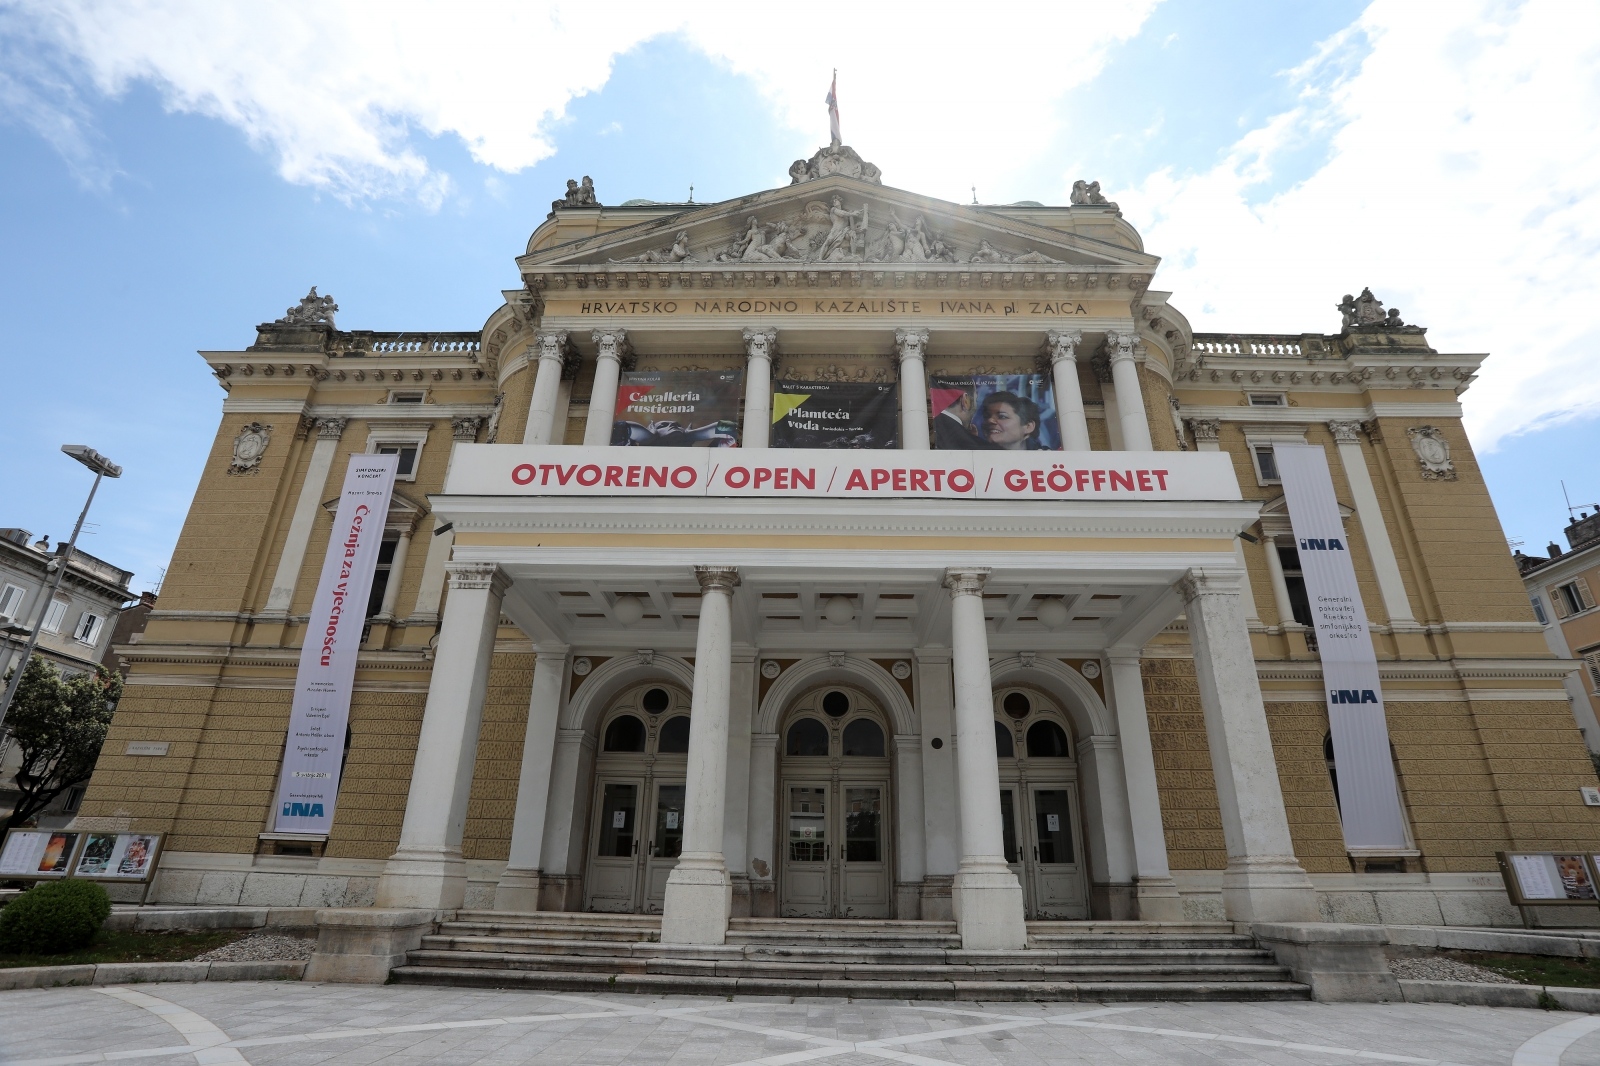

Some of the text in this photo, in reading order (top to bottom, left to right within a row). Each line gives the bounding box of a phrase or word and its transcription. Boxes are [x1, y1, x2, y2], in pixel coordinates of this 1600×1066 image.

[581, 299, 1088, 316] HRVATSKO NARODNO KAZALIŠTE IVANA pl. ZAJCA
[629, 391, 700, 402] Cavalleria
[627, 404, 695, 413] rusticana
[788, 407, 850, 419] Plamteća
[787, 420, 819, 430] voda
[512, 463, 697, 488] OTVORENO
[724, 466, 816, 489] OPEN
[845, 468, 975, 492] APERTO
[1004, 464, 1169, 492] GEÖFFNET
[320, 504, 370, 667] Čežnja za vječnošću
[1323, 613, 1353, 621] Riječkog
[1320, 623, 1361, 631] simfonijskog
